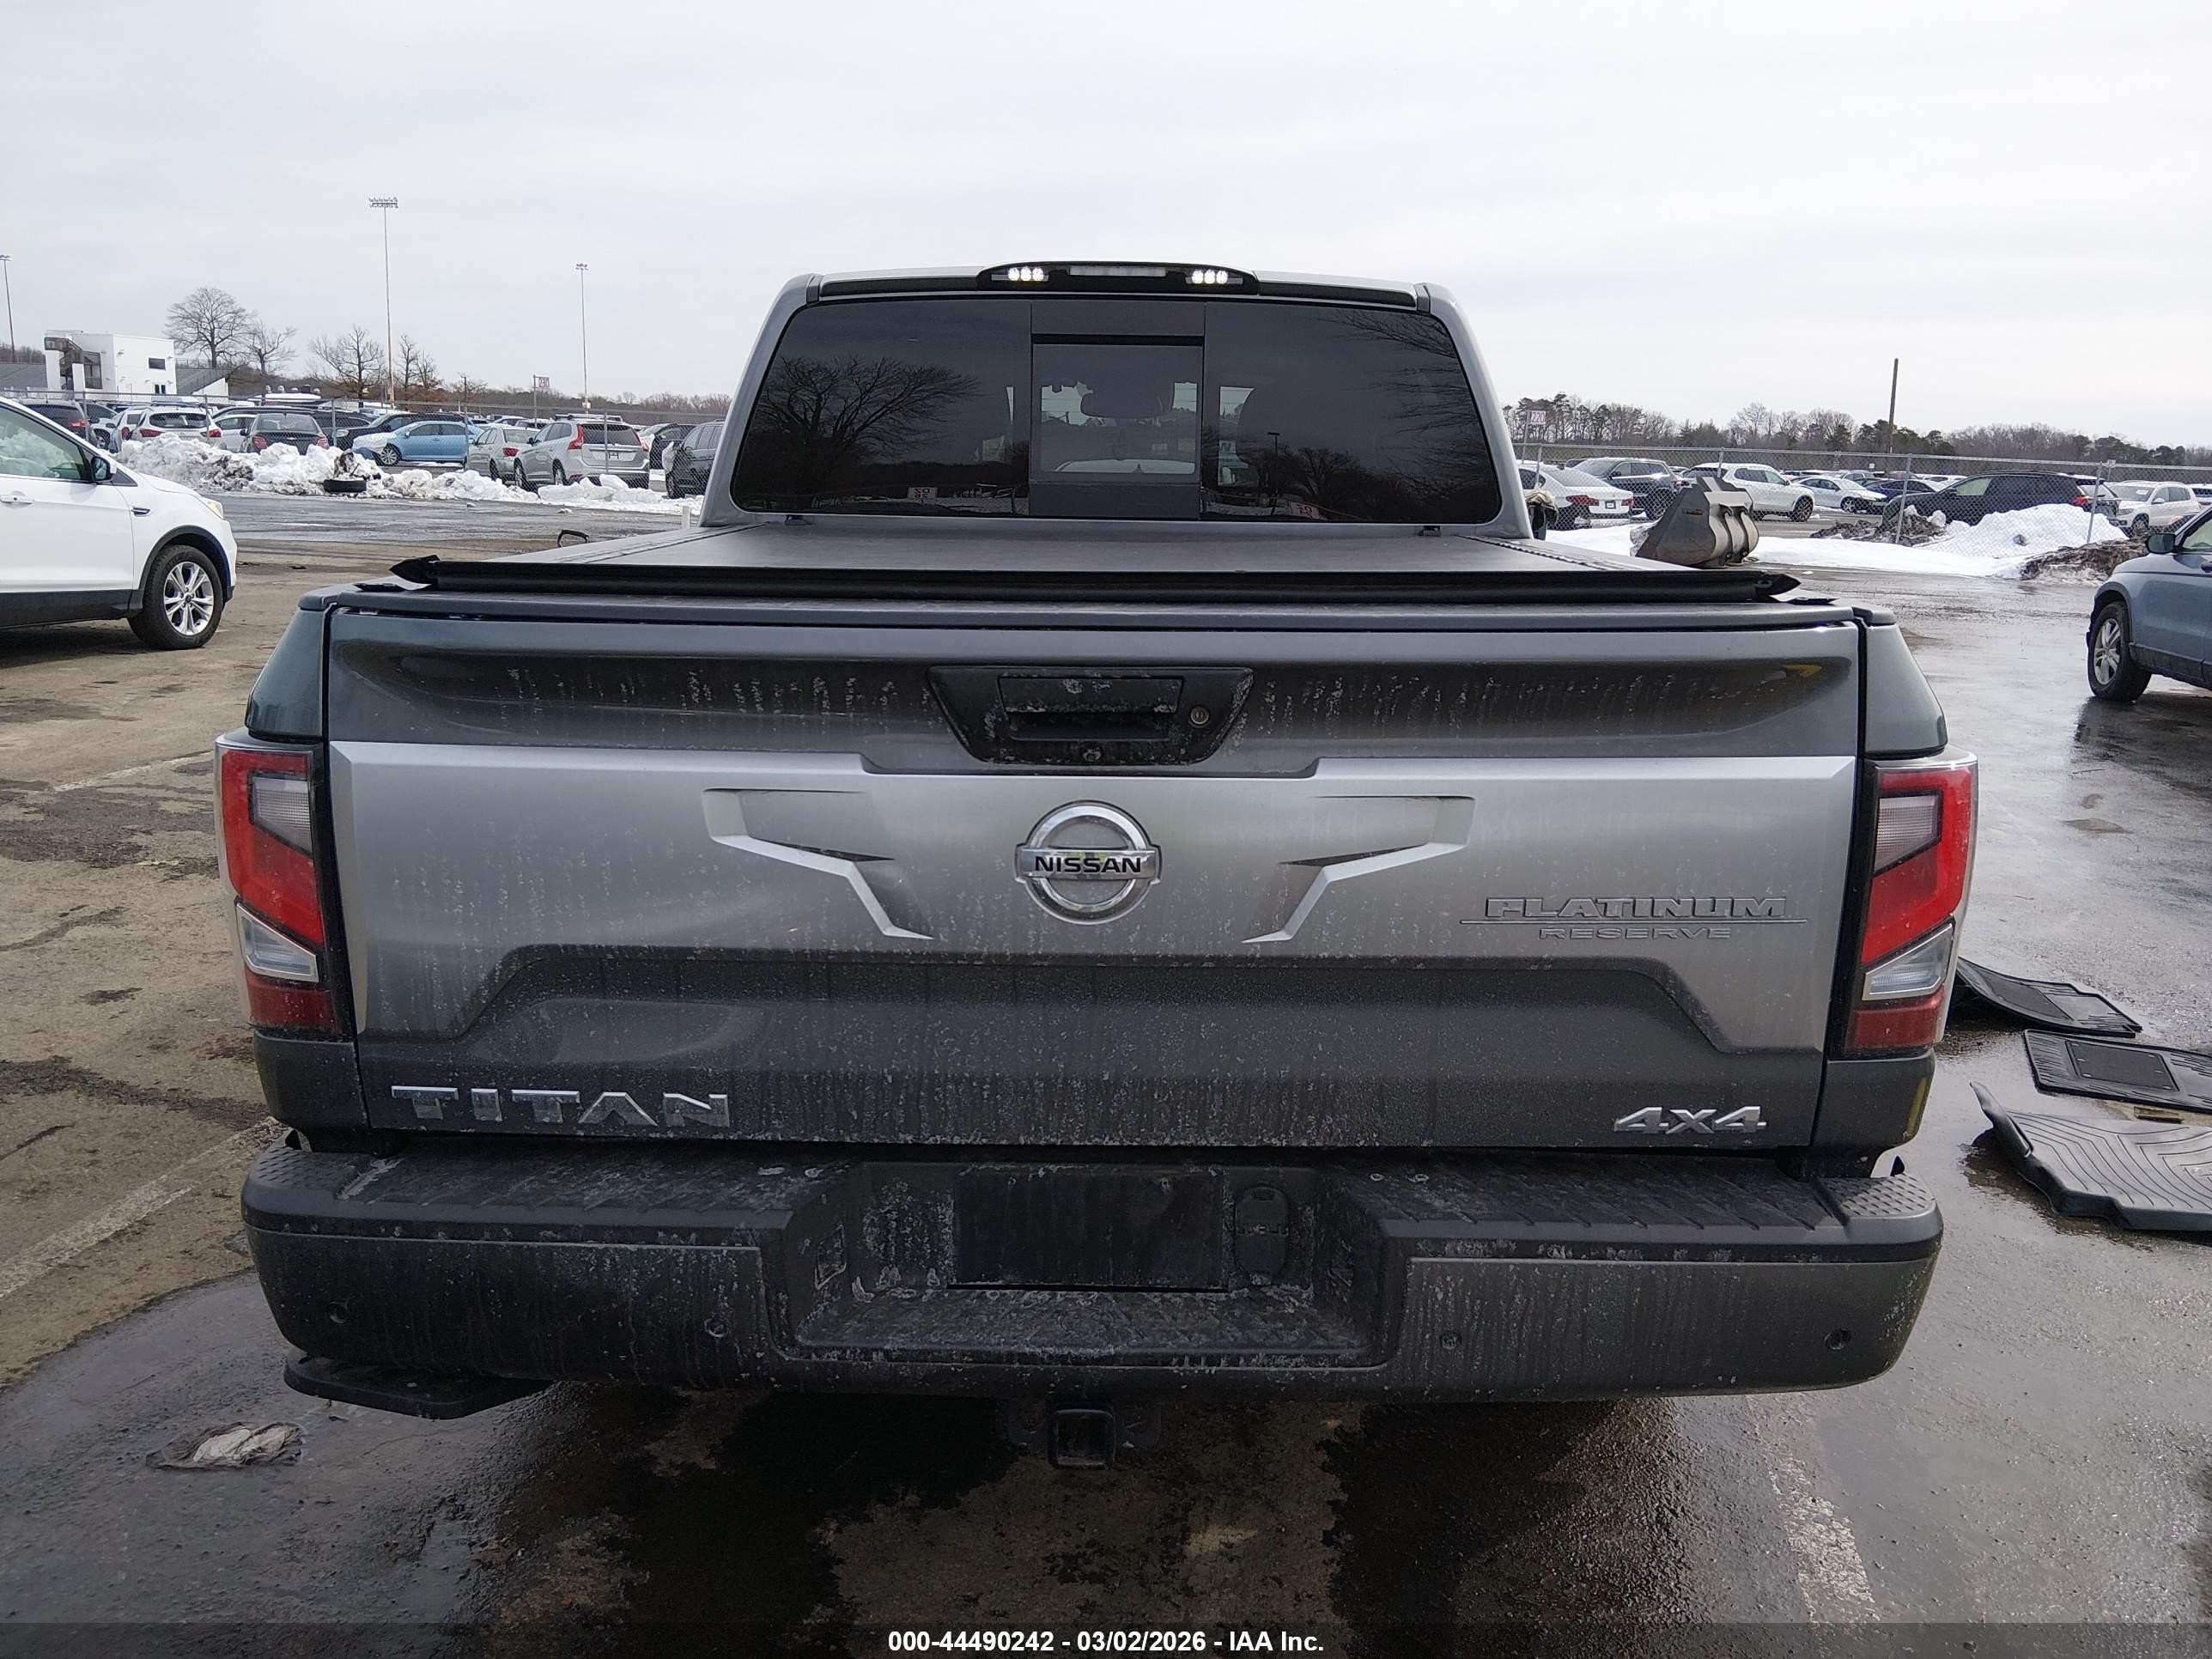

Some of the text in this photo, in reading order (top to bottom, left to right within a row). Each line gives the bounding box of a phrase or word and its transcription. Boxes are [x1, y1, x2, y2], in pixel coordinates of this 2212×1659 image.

[1531, 411, 1546, 423] 220
[1034, 855, 1142, 874] NISSAN
[1485, 896, 1787, 920] PLATINUM
[1538, 927, 1732, 940] RESERVE
[391, 1085, 731, 1127] TITAN
